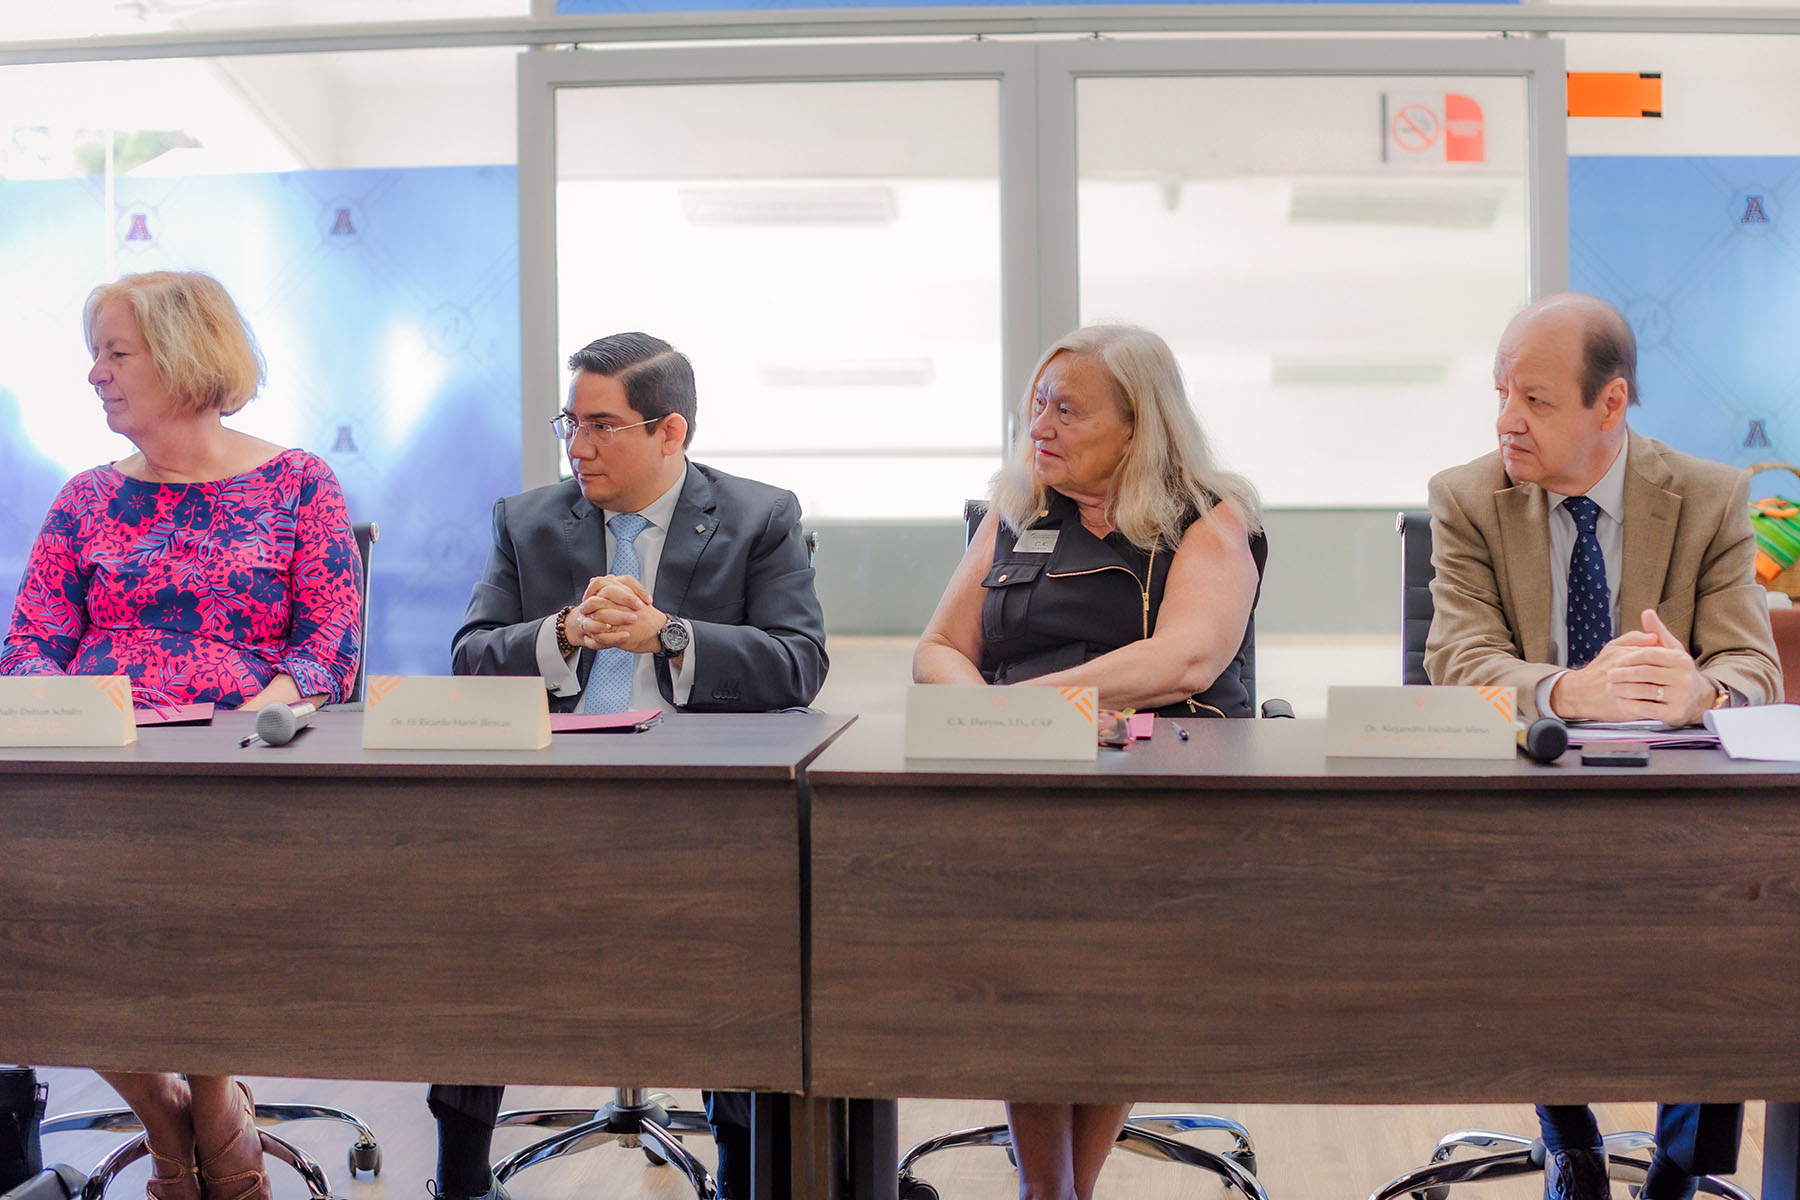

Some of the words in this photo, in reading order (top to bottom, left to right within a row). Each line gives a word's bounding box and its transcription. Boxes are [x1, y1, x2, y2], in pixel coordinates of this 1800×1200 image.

[331, 208, 357, 235] A
[1742, 195, 1770, 223] A
[125, 214, 153, 240] A
[331, 425, 358, 453] A
[1743, 419, 1772, 448] A
